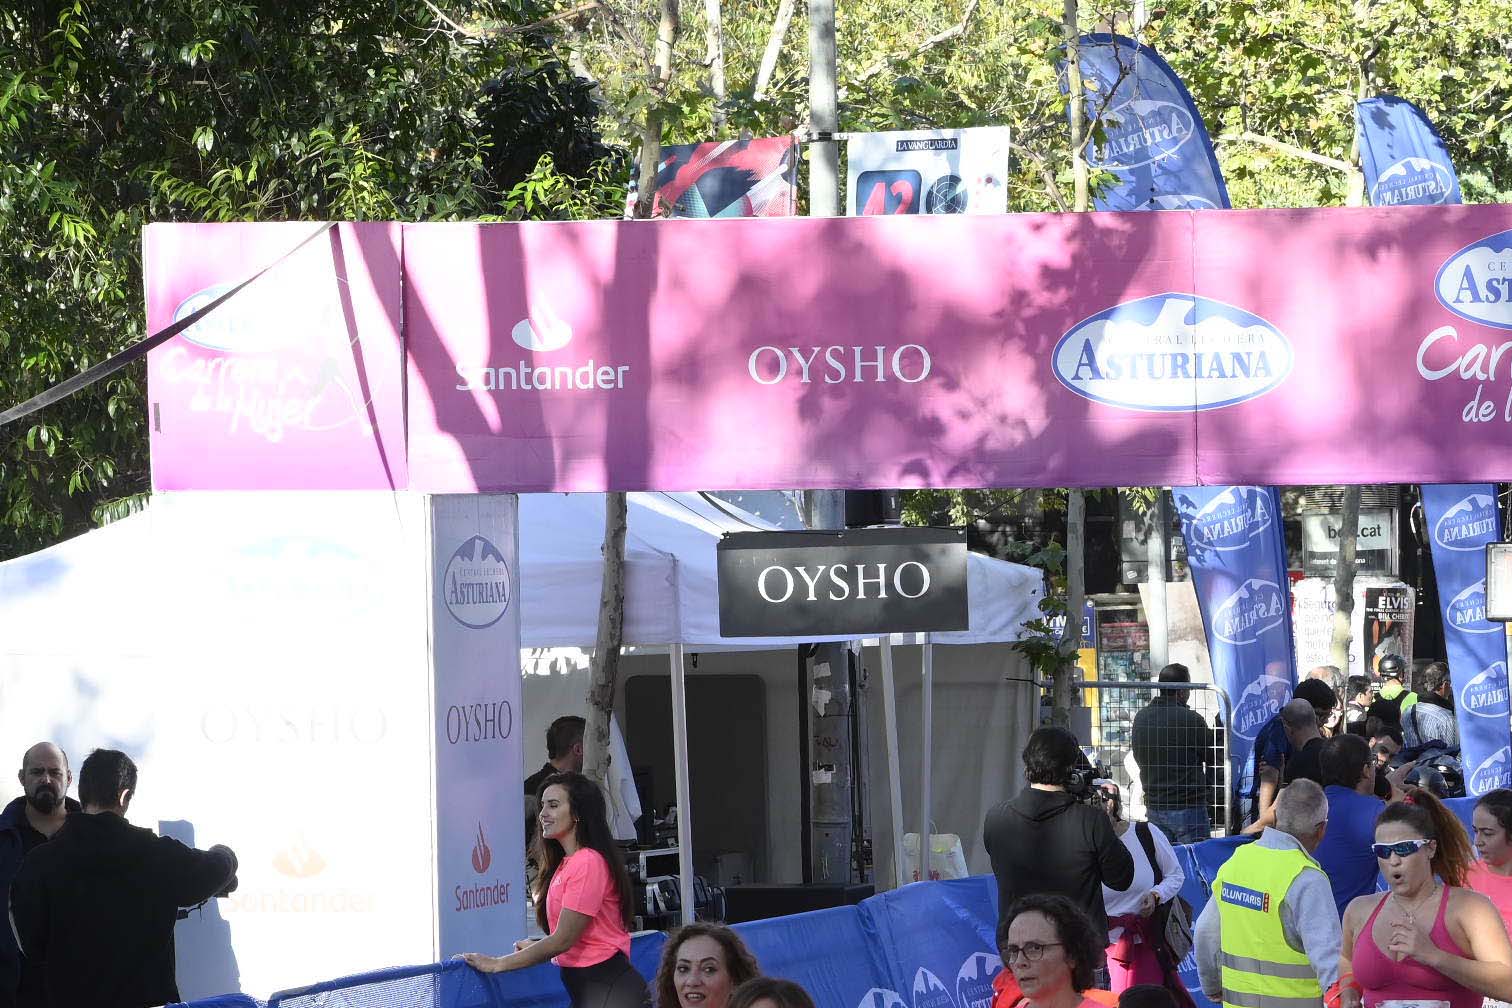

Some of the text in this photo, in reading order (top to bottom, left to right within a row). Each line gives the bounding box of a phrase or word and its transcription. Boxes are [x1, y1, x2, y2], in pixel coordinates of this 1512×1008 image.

[908, 138, 957, 151] VANGUARDIA
[455, 359, 630, 391] Santander
[747, 343, 932, 385] OYSHO
[1071, 337, 1274, 382] ASTURIANA
[1462, 384, 1496, 423] de
[448, 570, 507, 605] ASTURIANA
[757, 560, 932, 603] OYSHO
[1378, 596, 1409, 609] ELVIS
[1378, 612, 1391, 620] BILL
[446, 700, 513, 745] OYSHO
[455, 879, 511, 913] Santander
[1222, 887, 1262, 907] OLUNTARIS
